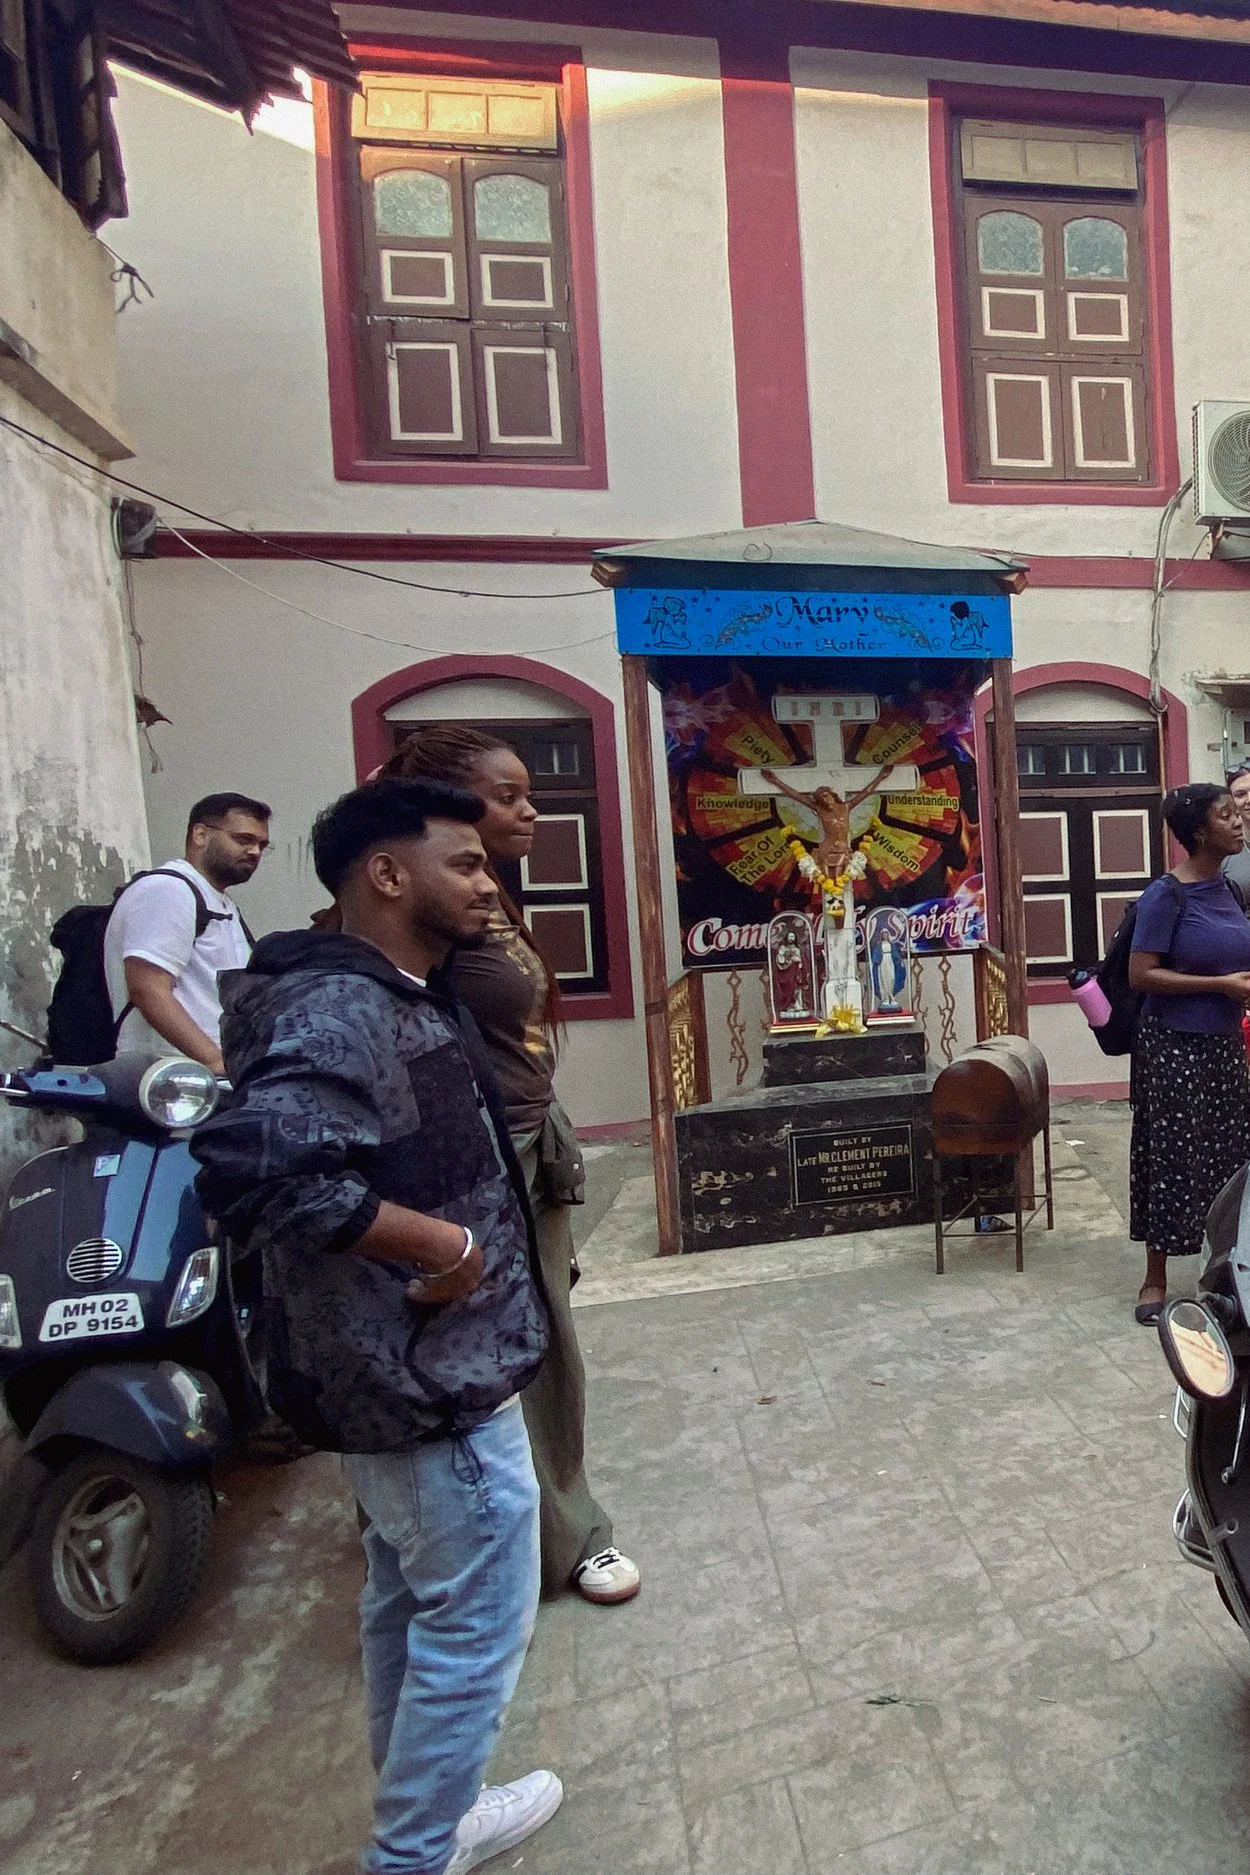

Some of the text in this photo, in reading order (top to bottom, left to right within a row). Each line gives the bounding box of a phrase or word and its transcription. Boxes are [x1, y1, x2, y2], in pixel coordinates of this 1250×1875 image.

[775, 595, 869, 636] Mary
[761, 636, 887, 653] Our Mother
[790, 701, 862, 716] INRI
[741, 734, 775, 764] Piety
[872, 722, 922, 765] Counsel
[697, 797, 769, 811] Knowledge
[888, 795, 959, 810] Understanding
[728, 835, 775, 876] Fear Of
[873, 831, 920, 872] Wisdom
[739, 864, 767, 883] The
[833, 1136, 872, 1147] BUILT BY
[797, 1156, 817, 1167] LATE
[831, 1148, 871, 1163] CLEMENT
[872, 1144, 910, 1159] PEREIRA
[842, 1163, 866, 1172] BUILT
[869, 1161, 881, 1169] BY
[820, 1170, 888, 1184] THE VILLAGERS
[62, 1298, 129, 1318] MH 02
[48, 1314, 139, 1338] DP 9154
